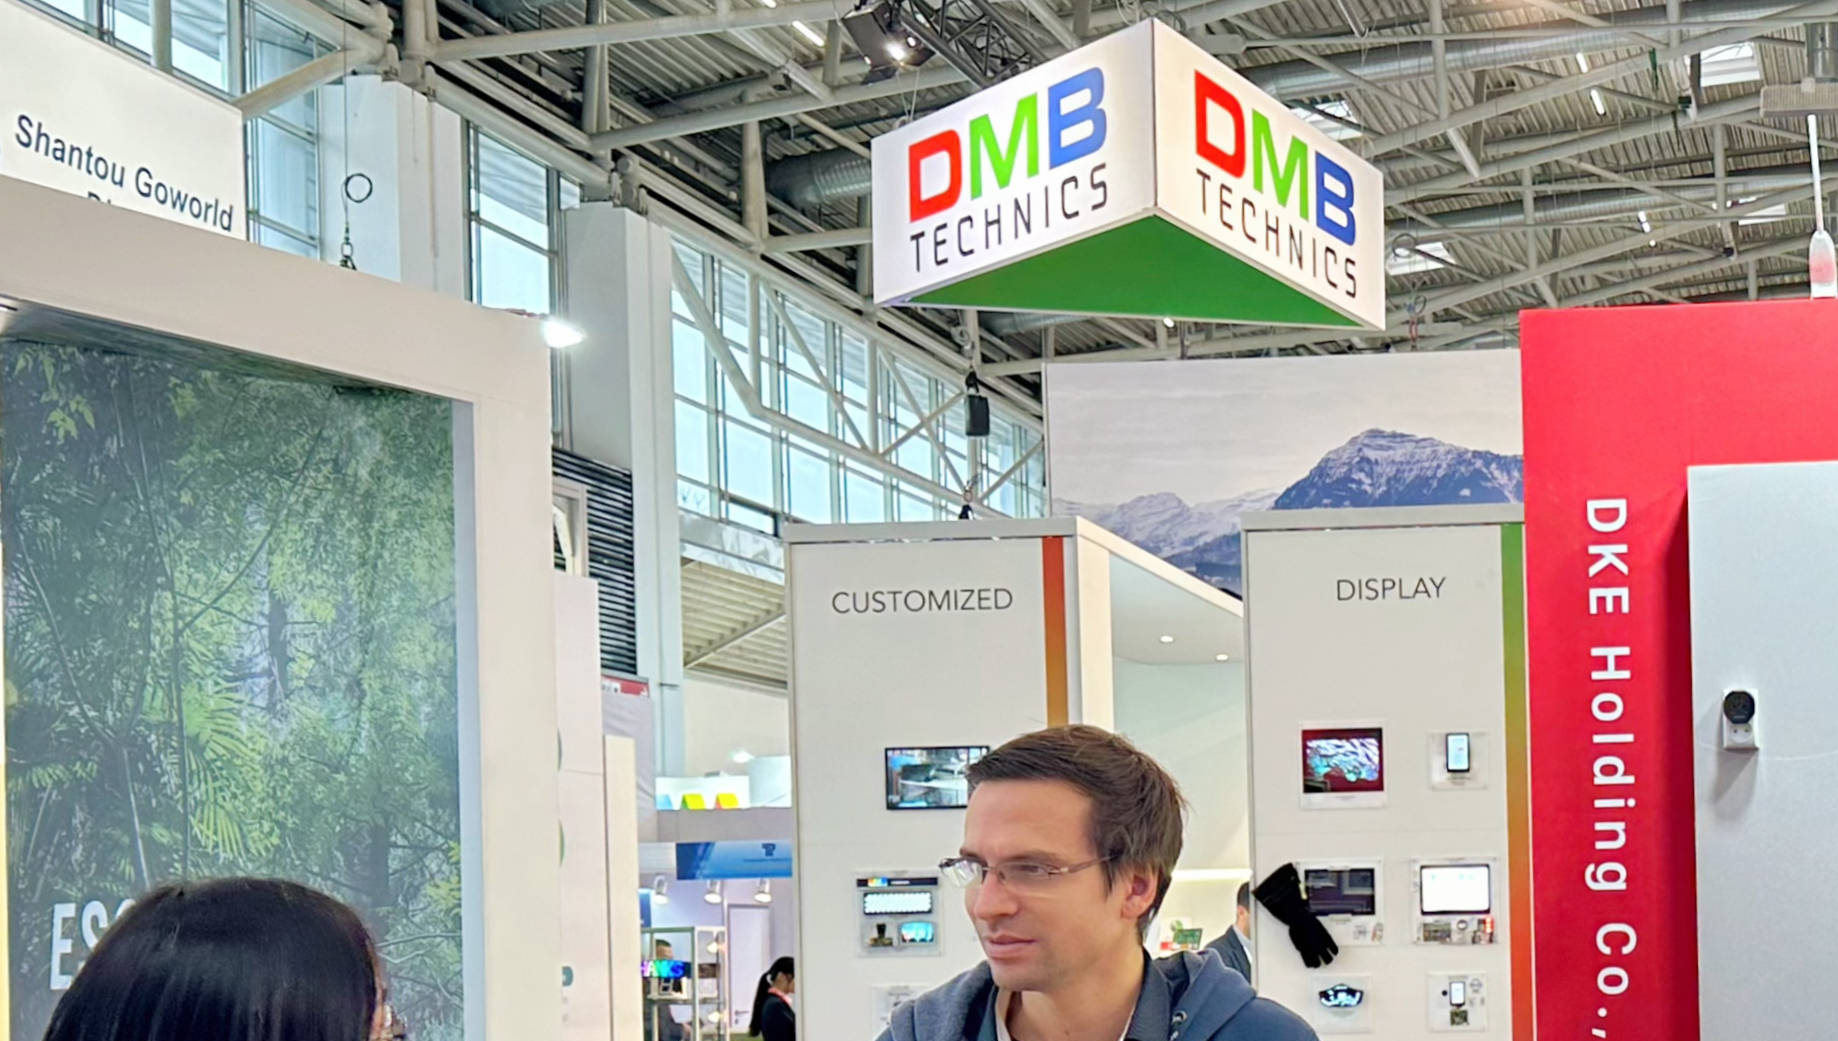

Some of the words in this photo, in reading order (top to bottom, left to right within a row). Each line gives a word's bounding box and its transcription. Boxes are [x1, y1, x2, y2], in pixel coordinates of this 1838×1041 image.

[15, 113, 126, 188] Shantou
[135, 166, 235, 232] Goworld
[908, 66, 1107, 222] DMB
[1194, 69, 1356, 247] DMB
[910, 162, 1108, 273] TECHNICS
[1195, 168, 1357, 299] TECHNICS
[831, 587, 1013, 614] CUSTOMIZED
[1335, 576, 1446, 603] DISPLAY
[1586, 498, 1630, 615] DKE
[1584, 646, 1636, 891] Holding
[50, 898, 136, 990] ES
[1591, 922, 1638, 1039] Co.,
